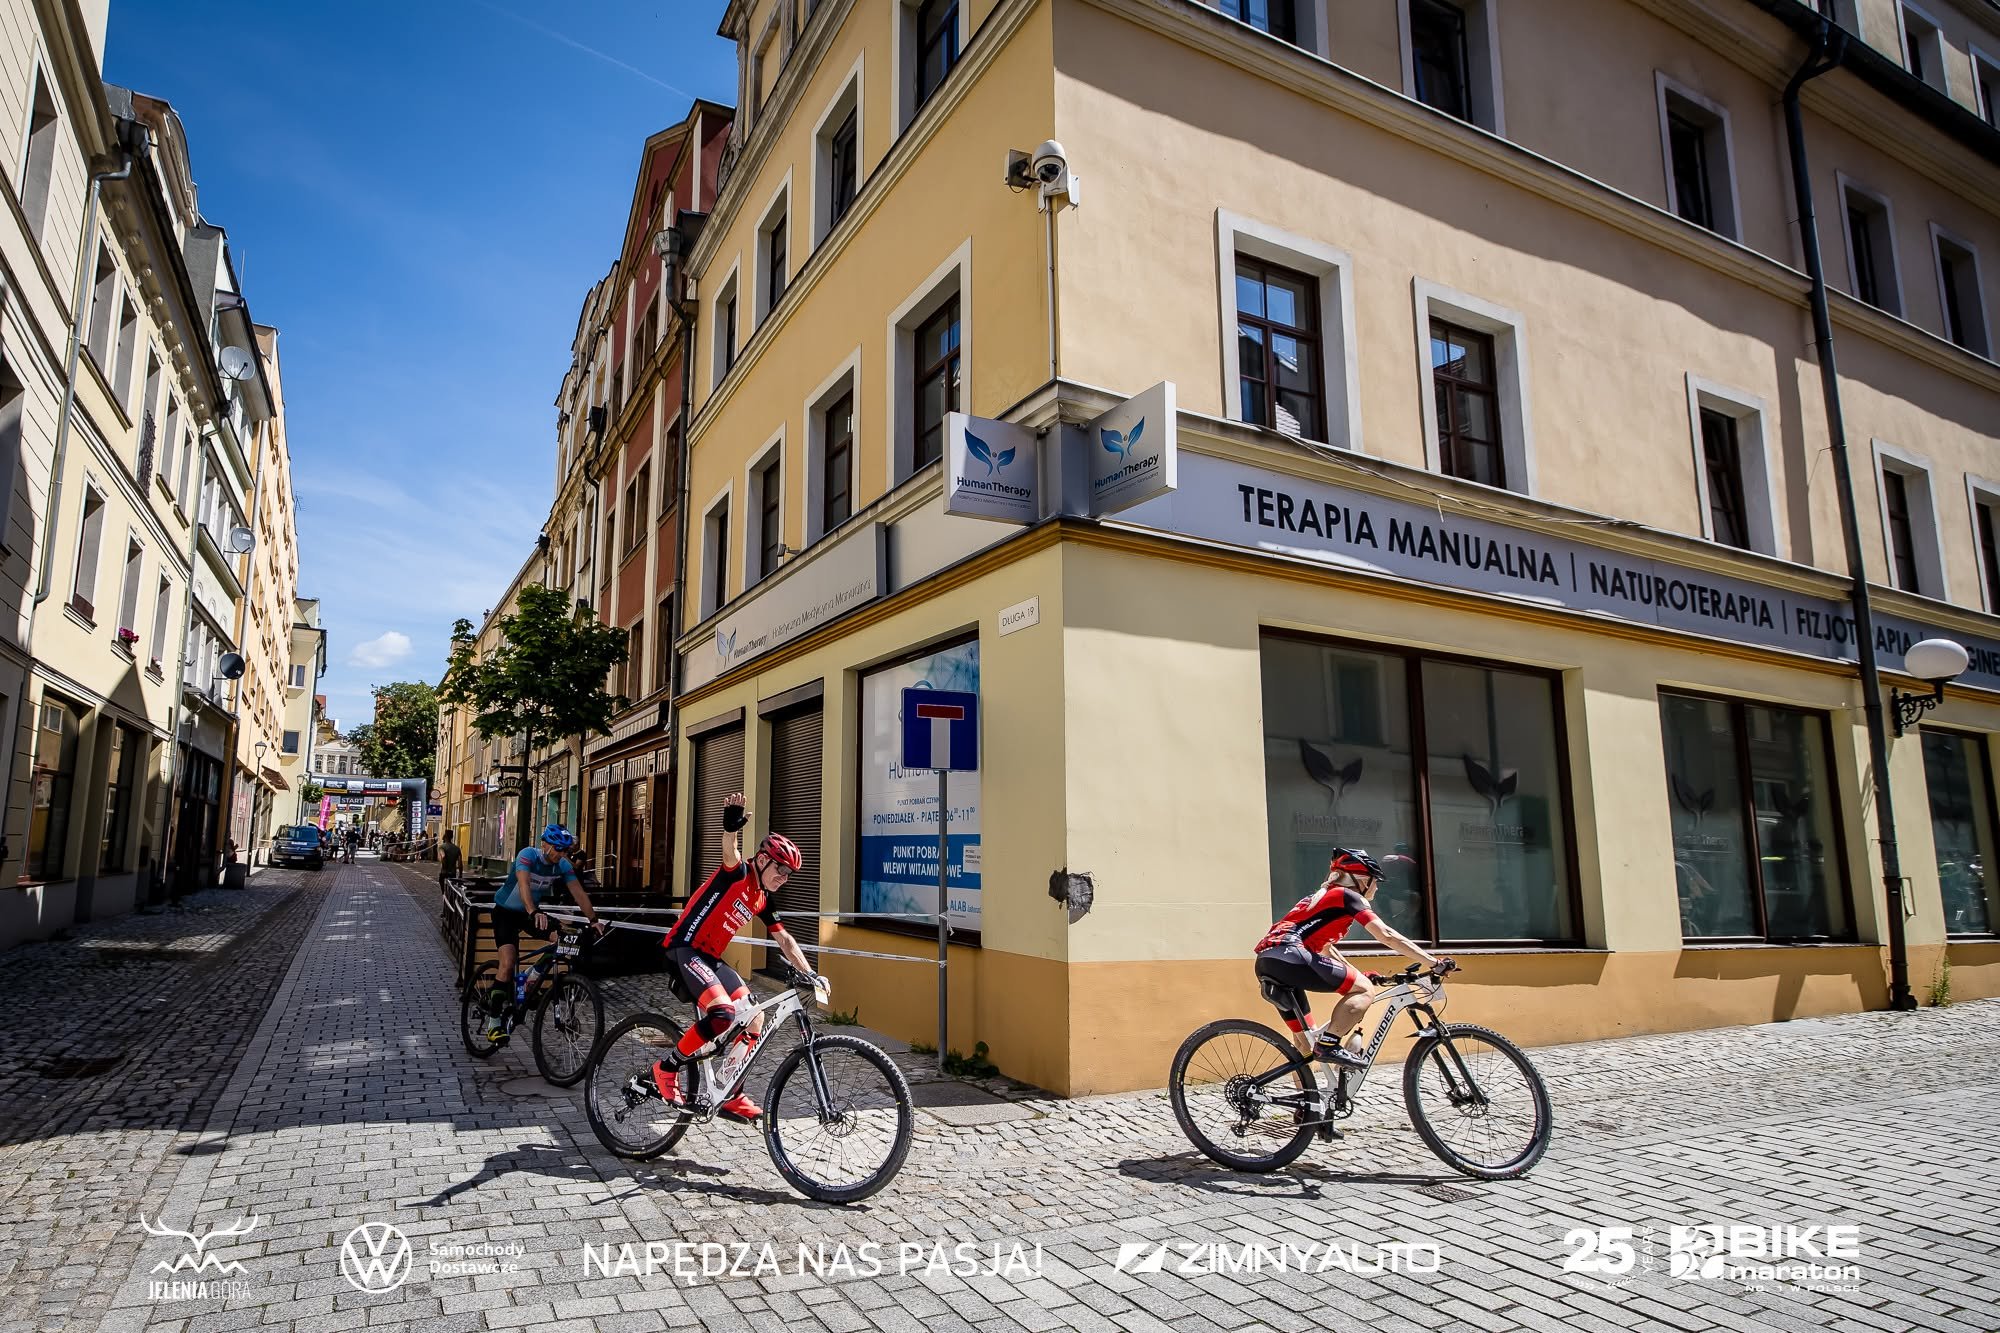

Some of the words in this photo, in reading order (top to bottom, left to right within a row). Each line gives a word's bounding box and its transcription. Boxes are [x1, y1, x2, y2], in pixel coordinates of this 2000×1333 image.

[1094, 454, 1159, 489] HumanTherapy
[956, 476, 1032, 498] HumanTherapy
[1237, 483, 1378, 549] TERAPIA
[1388, 518, 1560, 586] MANUALNA
[1589, 562, 1774, 630] NATUROTERAPIA
[1796, 607, 1912, 657] FIZJOTAPIA
[873, 812, 915, 825] PONIEDZIAŁEK
[921, 811, 940, 825] PIĄTE
[893, 846, 915, 859] PUNKT
[916, 845, 949, 859] POBRA
[883, 862, 907, 874] WLEWY
[908, 863, 962, 878] WITAMINWE
[949, 899, 967, 913] ALAB
[563, 935, 579, 944] 437
[1361, 1003, 1397, 1071] OCKRIDER
